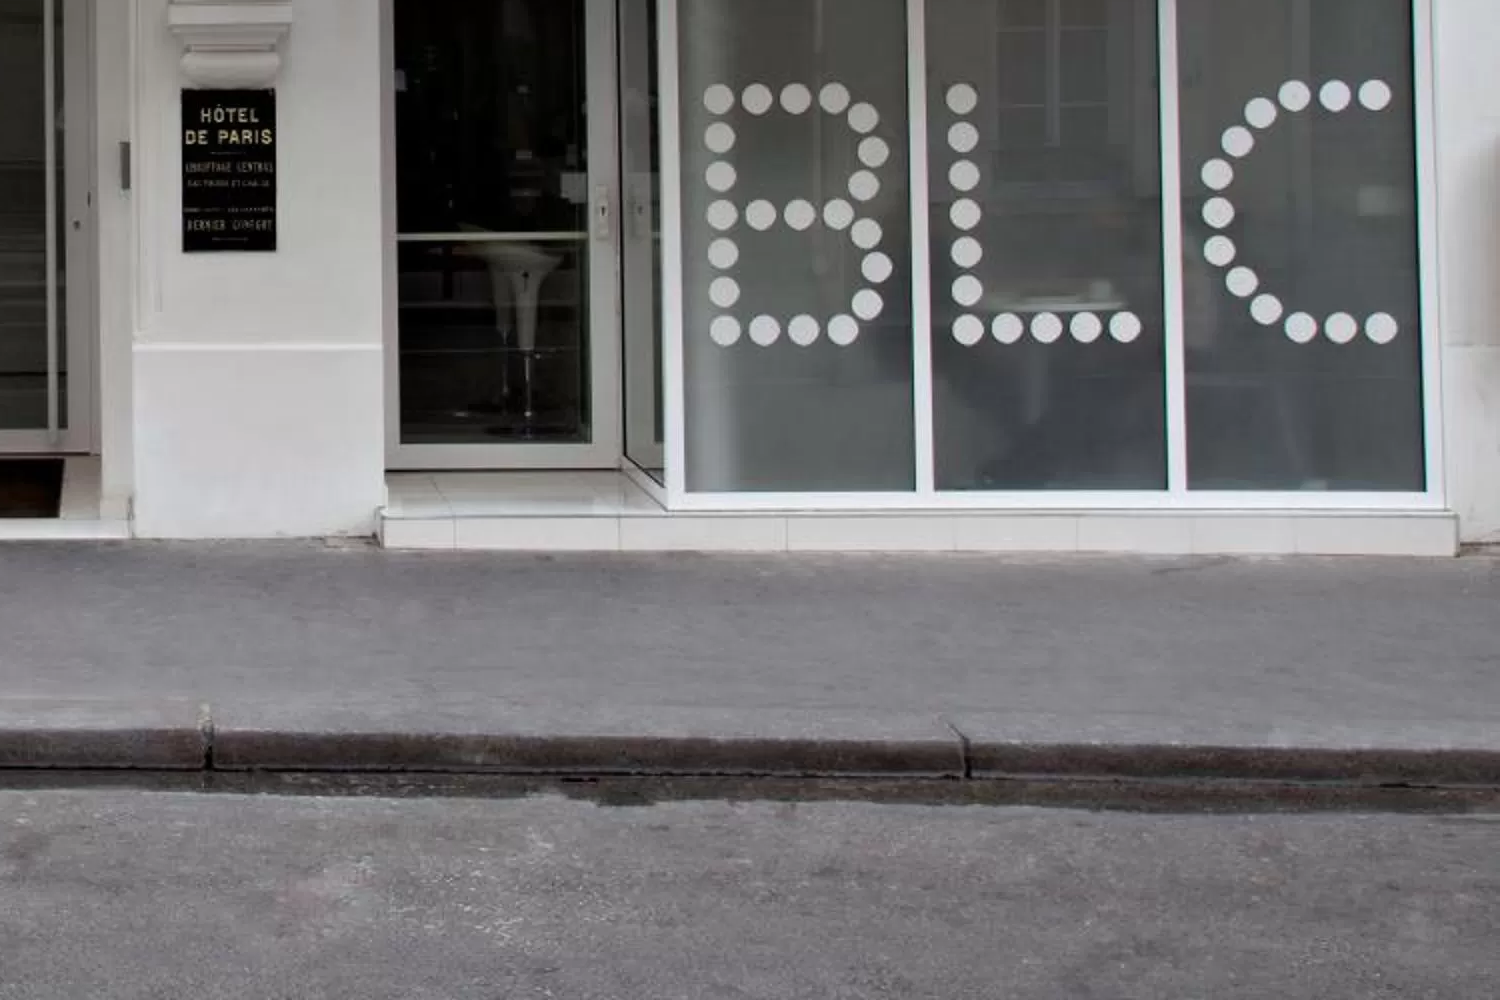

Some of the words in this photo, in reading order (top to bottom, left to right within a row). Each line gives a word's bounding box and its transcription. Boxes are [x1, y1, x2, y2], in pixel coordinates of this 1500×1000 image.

[200, 103, 259, 123] HÔTEL
[185, 129, 209, 145] DE
[217, 129, 273, 145] PARIS
[703, 79, 1398, 345] BLC
